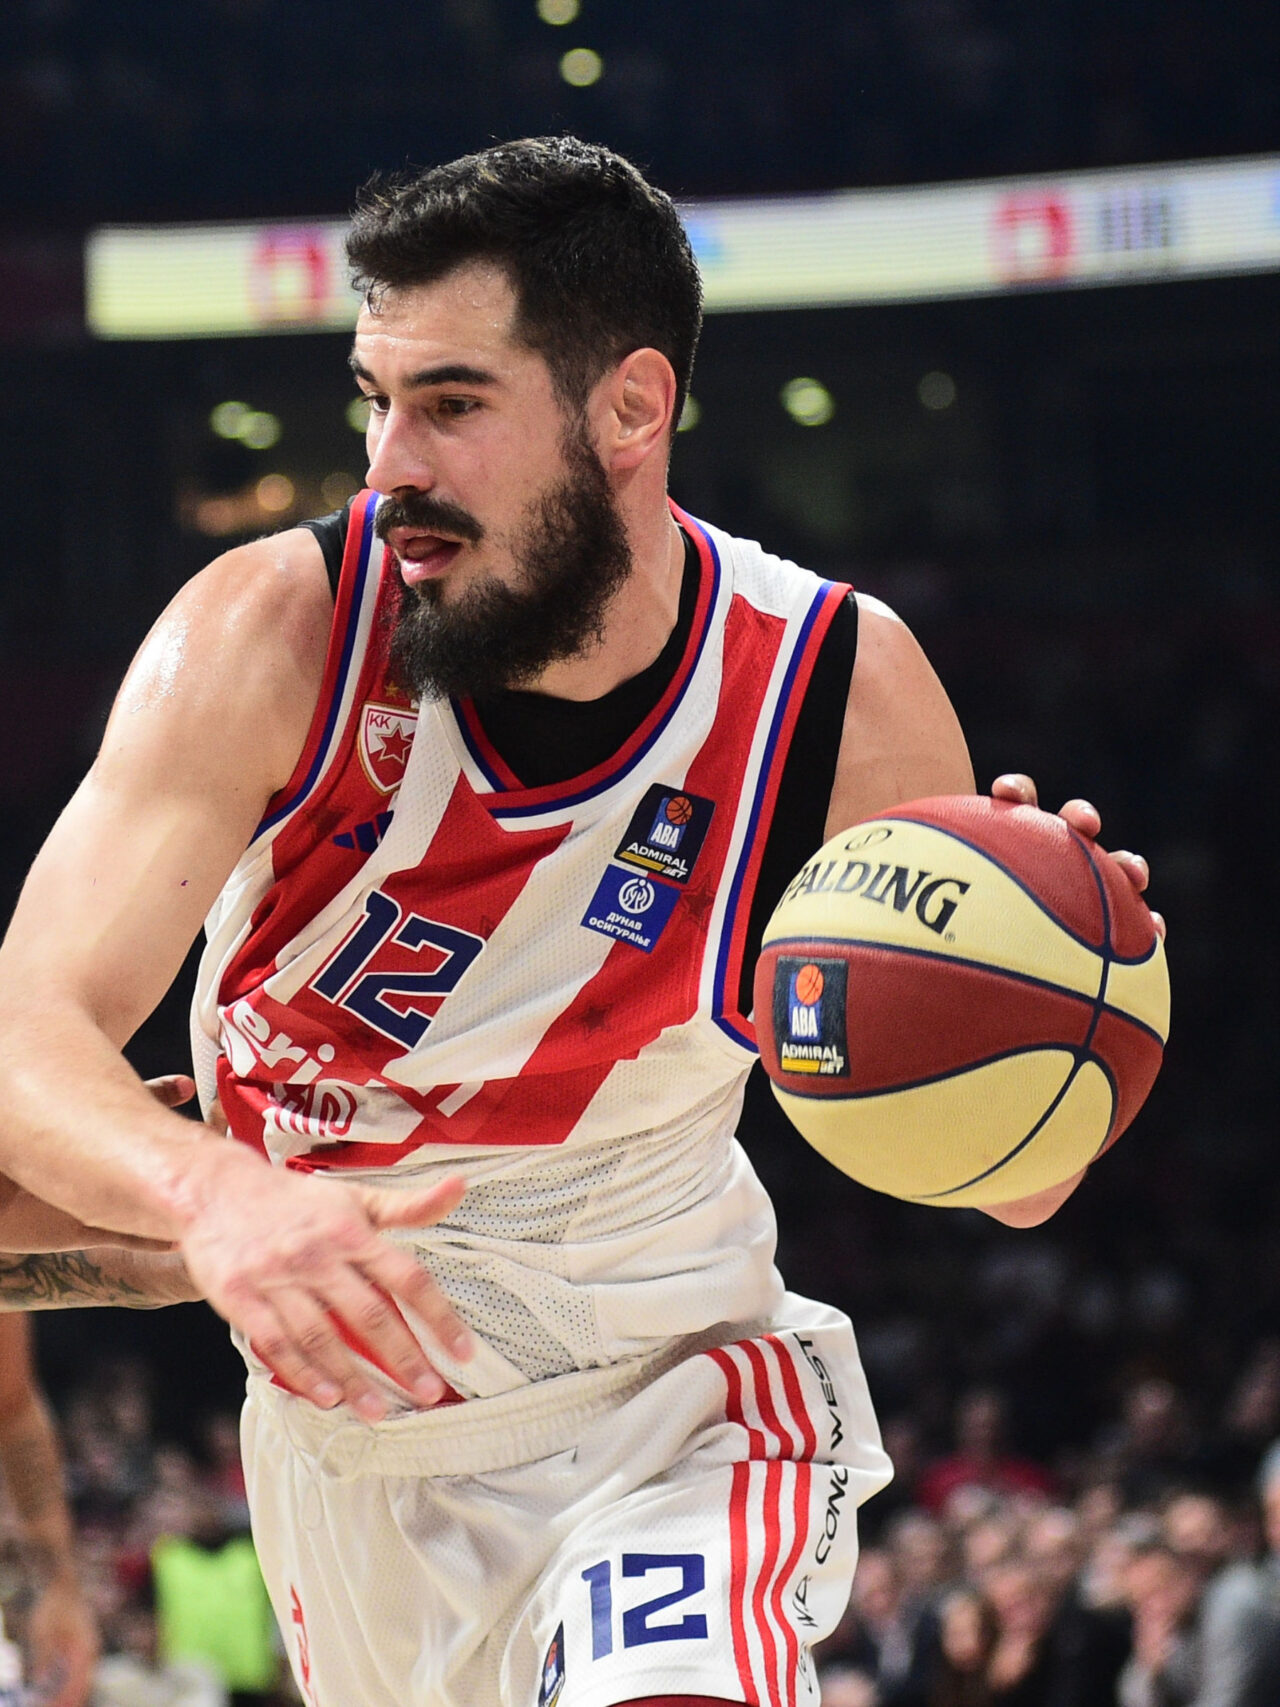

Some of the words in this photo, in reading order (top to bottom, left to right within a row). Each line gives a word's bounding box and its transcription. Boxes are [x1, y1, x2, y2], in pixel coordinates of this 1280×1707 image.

[369, 713, 391, 729] KK
[650, 822, 681, 849] ABA
[626, 842, 689, 872] ADMIRAL
[776, 859, 972, 936] PALDING
[606, 912, 643, 931] ДУНАВ
[308, 891, 487, 1051] 12
[791, 1005, 819, 1038] ABA
[781, 1042, 843, 1062] ADMIRAL
[791, 1332, 846, 1450] WEST
[580, 1552, 709, 1662] 12
